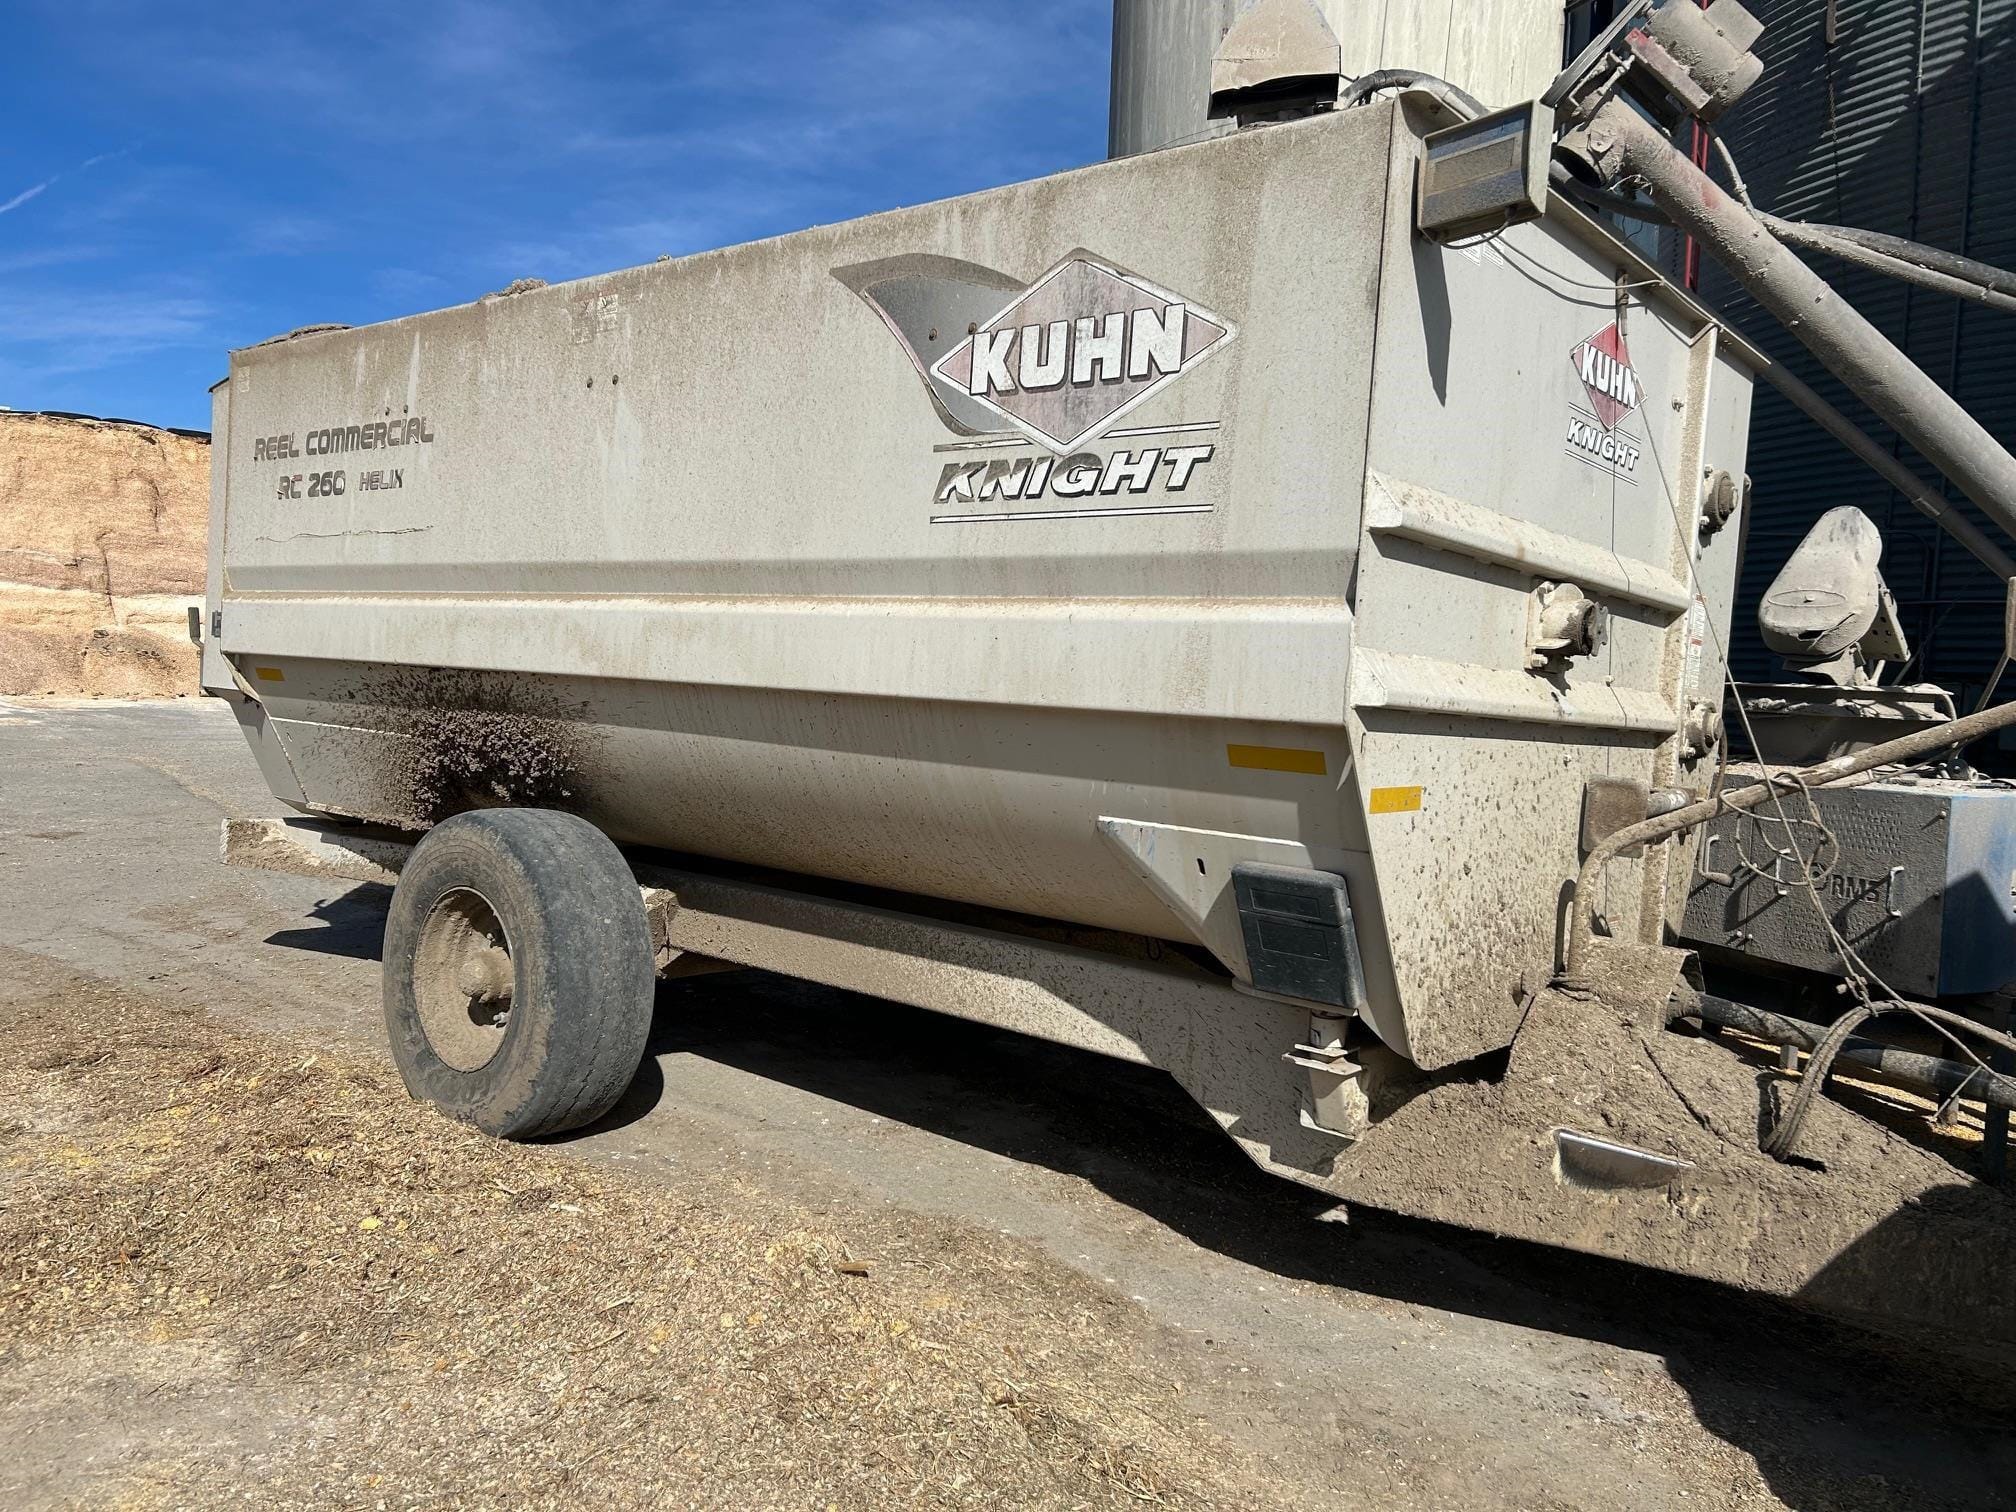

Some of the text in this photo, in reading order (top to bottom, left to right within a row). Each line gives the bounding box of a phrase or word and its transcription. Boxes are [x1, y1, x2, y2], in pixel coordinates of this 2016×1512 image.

[969, 303, 1188, 396] KUHN
[1581, 342, 1637, 409] KUHN
[254, 416, 434, 462] REEL COMMERCIAL
[1567, 417, 1640, 471] KNIGHT
[277, 468, 404, 500] RC 260 HELIX
[934, 445, 1214, 504] KNIGHT
